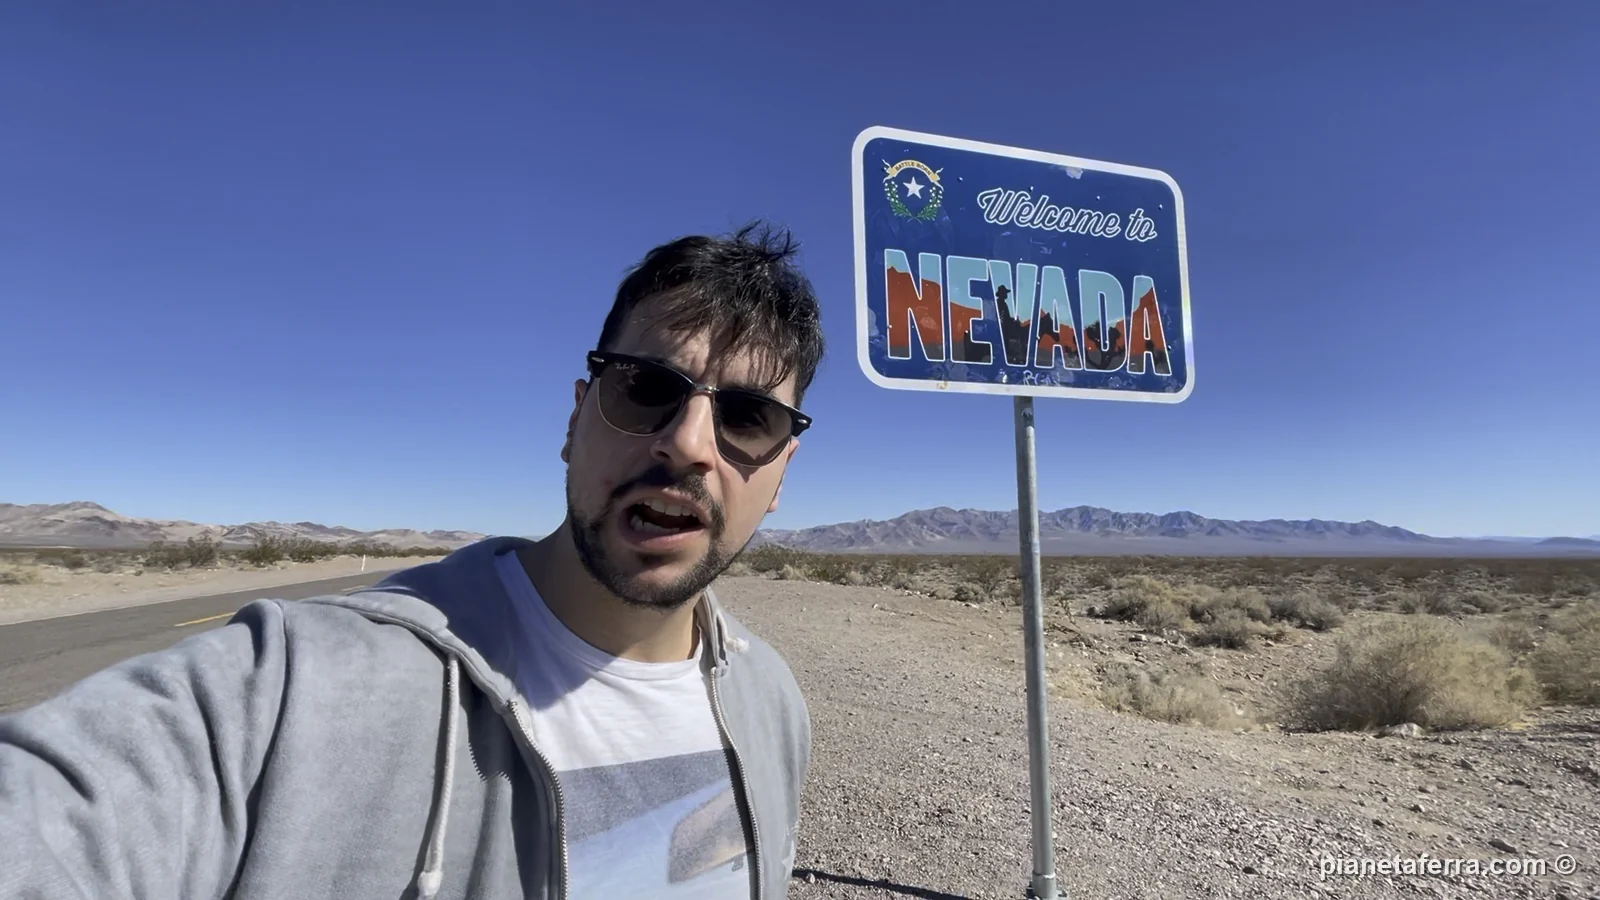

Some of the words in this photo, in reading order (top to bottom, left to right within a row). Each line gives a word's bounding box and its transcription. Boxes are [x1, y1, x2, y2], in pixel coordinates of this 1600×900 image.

[977, 187, 1121, 237] Welcome
[1125, 208, 1158, 242] to
[884, 249, 1172, 375] NEVADA
